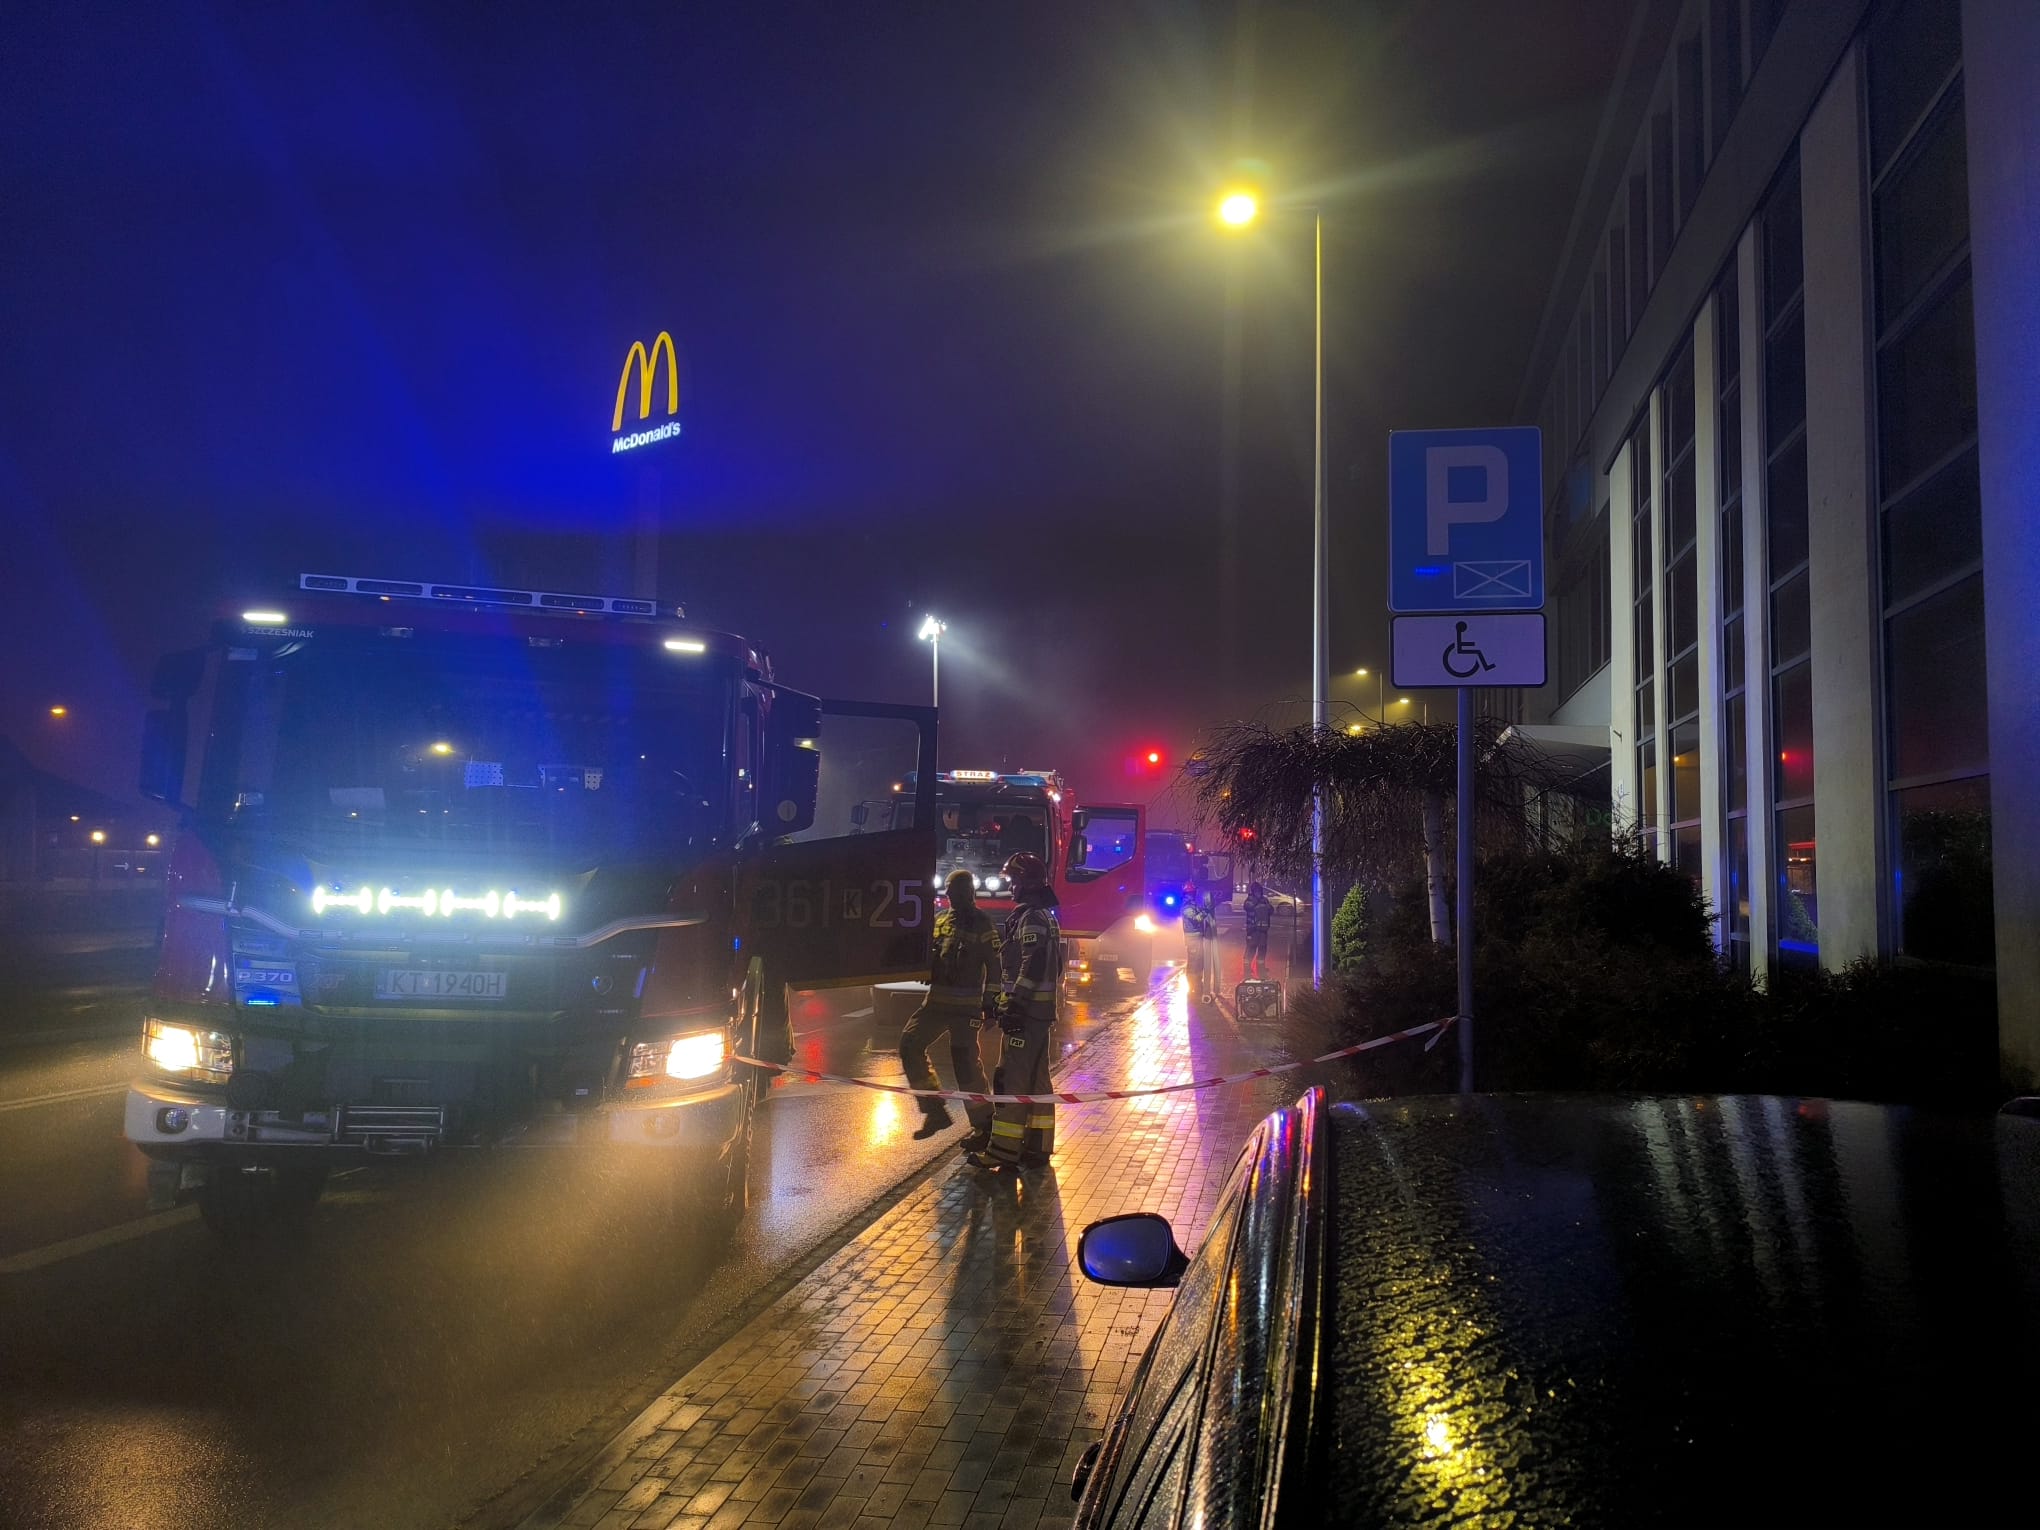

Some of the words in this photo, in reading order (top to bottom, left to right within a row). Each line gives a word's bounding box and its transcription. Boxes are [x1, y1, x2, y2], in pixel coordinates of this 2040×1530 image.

[612, 421, 681, 454] McDonald's
[1426, 445, 1509, 556] P
[869, 880, 922, 927] 25
[255, 972, 292, 982] 370
[391, 972, 422, 993] KT
[433, 973, 500, 995] 1940H
